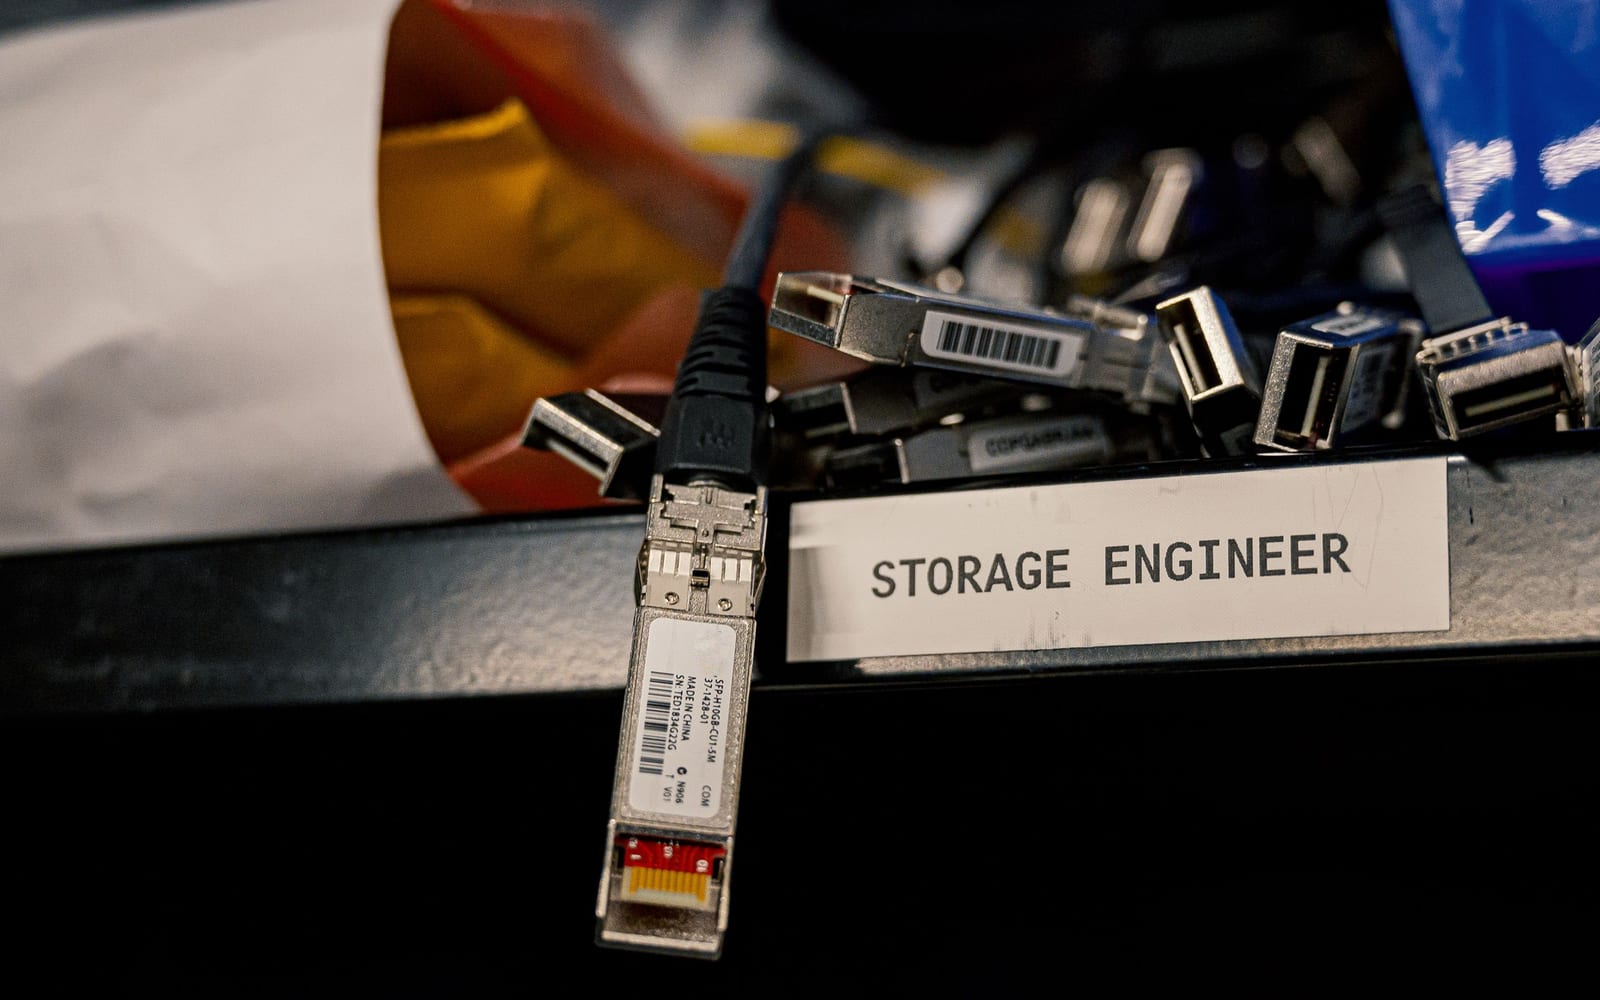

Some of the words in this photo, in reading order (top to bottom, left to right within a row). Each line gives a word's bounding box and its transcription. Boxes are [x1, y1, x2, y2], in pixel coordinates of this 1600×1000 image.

[871, 548, 1071, 599] STORAGE
[1104, 532, 1352, 587] ENGINEER
[685, 675, 696, 701] MADE
[700, 678, 713, 724] 37-1428-01
[668, 690, 683, 751] TED1834G22G
[684, 703, 693, 712] IN
[681, 714, 692, 741] CHINA
[663, 786, 673, 802] V01
[676, 780, 686, 804] N906
[701, 784, 711, 807] COM
